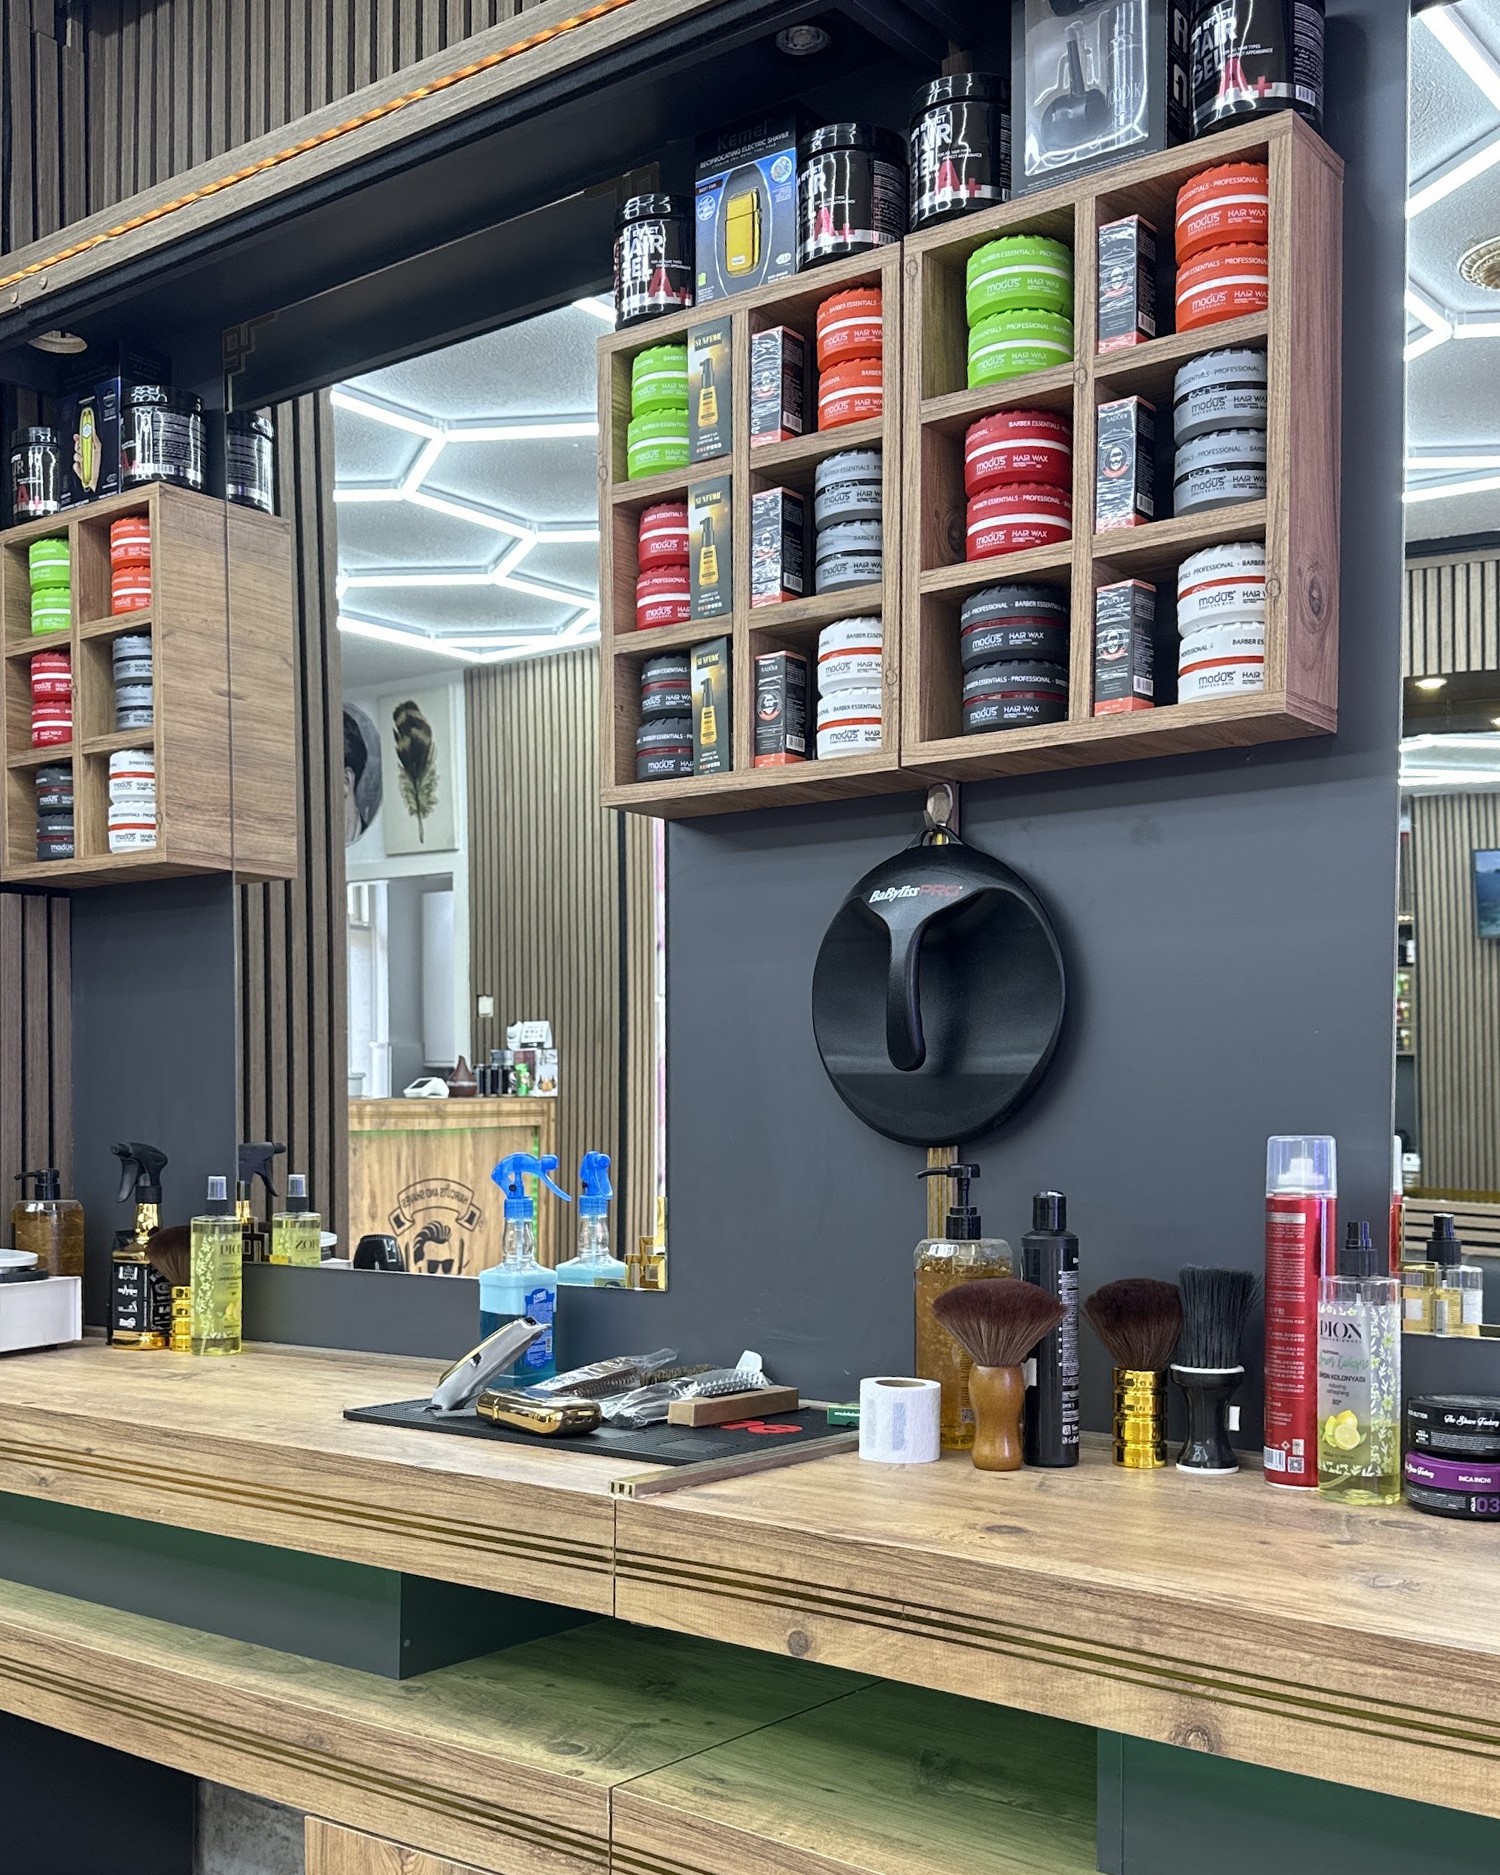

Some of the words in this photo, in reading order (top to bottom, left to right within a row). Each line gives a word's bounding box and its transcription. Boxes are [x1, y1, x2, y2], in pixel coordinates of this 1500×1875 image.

[700, 148, 741, 169] RECIPROCATING
[741, 139, 767, 153] ELECTRIC
[767, 131, 790, 144] SHAVER
[1213, 177, 1259, 188] PROFESSIONAL
[1227, 209, 1247, 217] HAIR
[1248, 209, 1266, 217] WAX
[1000, 249, 1035, 258] ESSENTIALS
[1027, 278, 1044, 286] HAIR
[1046, 279, 1060, 288] WAX
[1234, 290, 1253, 298] HAIR
[1255, 290, 1268, 298] WA
[846, 300, 877, 309] ESSENTIALS
[1006, 323, 1049, 332] PROFESSIONAL
[854, 329, 870, 337] HAIR
[1012, 352, 1029, 360] HAIR
[1031, 352, 1048, 360] WAX
[1214, 365, 1260, 376] PROFESSIONAL
[661, 383, 677, 391] HAIR
[854, 398, 871, 406] HAIR
[872, 398, 882, 406] WA
[1233, 395, 1252, 403] HAIR
[665, 449, 681, 457] HAIR
[1012, 454, 1030, 462] HAIR
[1032, 454, 1049, 463] WAX
[1232, 475, 1252, 483] HAIR
[987, 495, 1019, 505] ESSENTIALS
[1022, 495, 1060, 505] PROFESSIONAL
[657, 511, 683, 520] ESSENTIALS
[1011, 530, 1030, 538] HAIR
[1031, 530, 1048, 538] WAX
[1199, 591, 1235, 606] modus
[1242, 590, 1261, 598] HAIR
[972, 602, 1008, 615] PROFESSIONAL
[1014, 600, 1037, 608] BARBER
[1232, 638, 1256, 646] BARBER
[1198, 671, 1235, 686] modus
[1242, 671, 1261, 679] HAIR
[978, 677, 1007, 686] ESSENTIALS
[1011, 676, 1051, 684] PROFESSIONAL
[833, 705, 851, 713] BARBER
[1003, 705, 1021, 713] HAIR
[1330, 1373, 1366, 1383] KOLONYASI
[1476, 1496, 1500, 1513] 03
